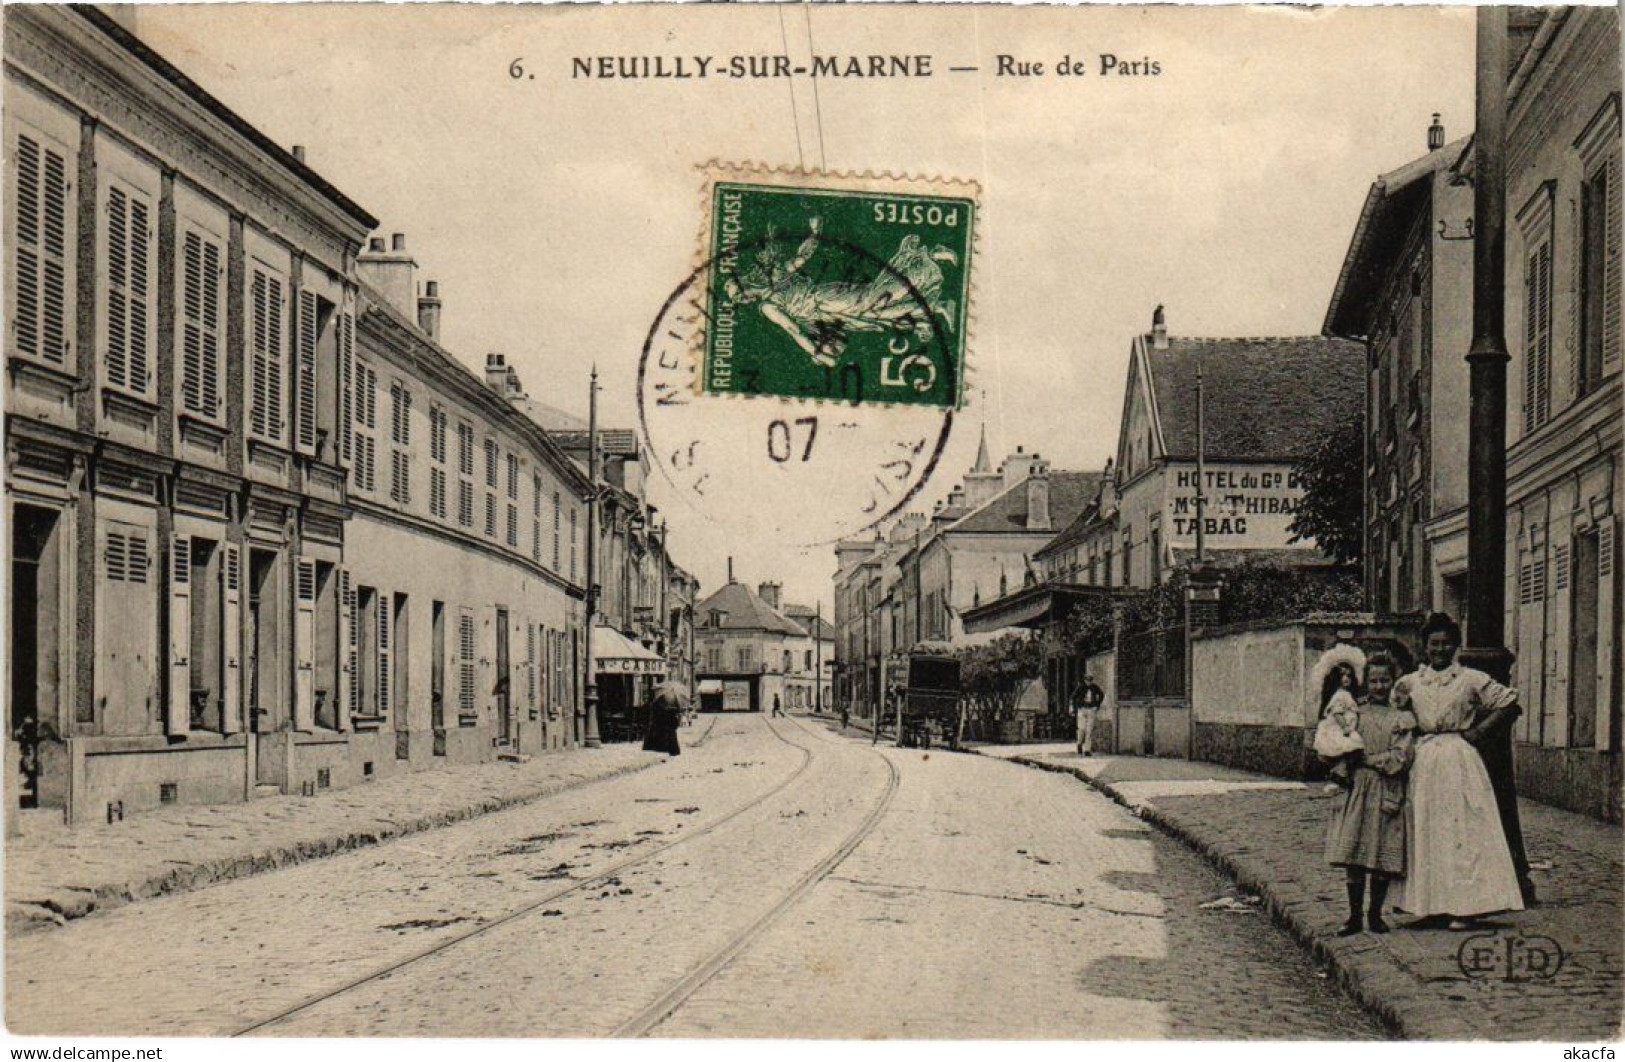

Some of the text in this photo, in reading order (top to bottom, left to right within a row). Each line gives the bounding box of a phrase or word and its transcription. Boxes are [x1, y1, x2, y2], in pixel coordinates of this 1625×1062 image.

[874, 202, 958, 227] POSTES
[767, 416, 818, 463] 07
[1177, 471, 1238, 488] HOTEL
[1173, 518, 1247, 535] TABAC
